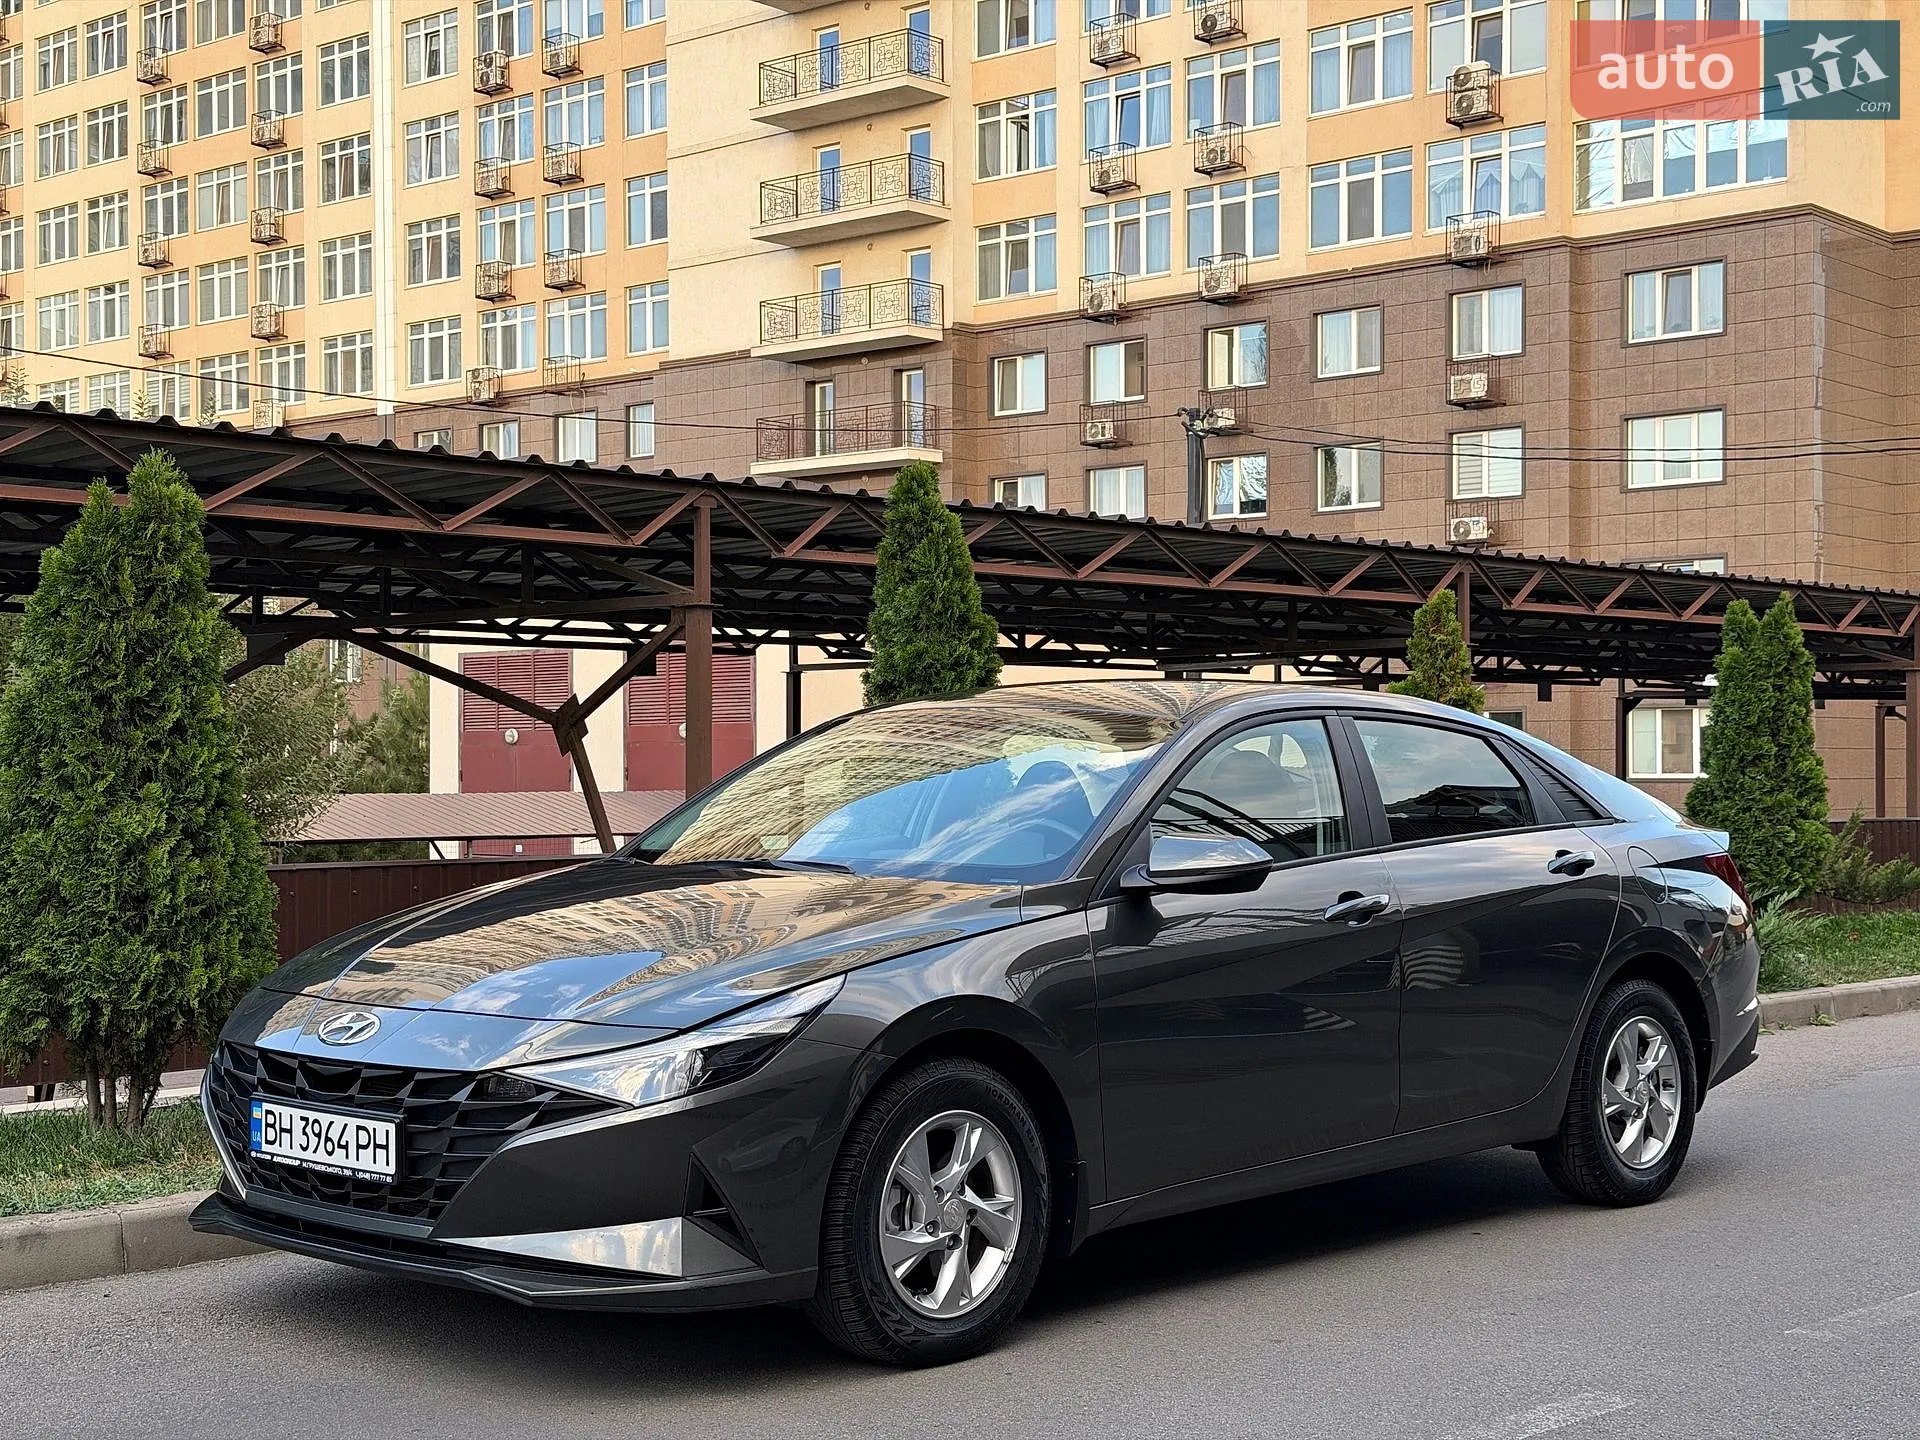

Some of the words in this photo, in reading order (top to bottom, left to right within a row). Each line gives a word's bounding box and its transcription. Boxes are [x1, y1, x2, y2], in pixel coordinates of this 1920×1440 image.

[252, 1131, 262, 1142] UA
[264, 1109, 293, 1150] BH
[299, 1115, 349, 1160] 3964
[356, 1125, 390, 1166] PH
